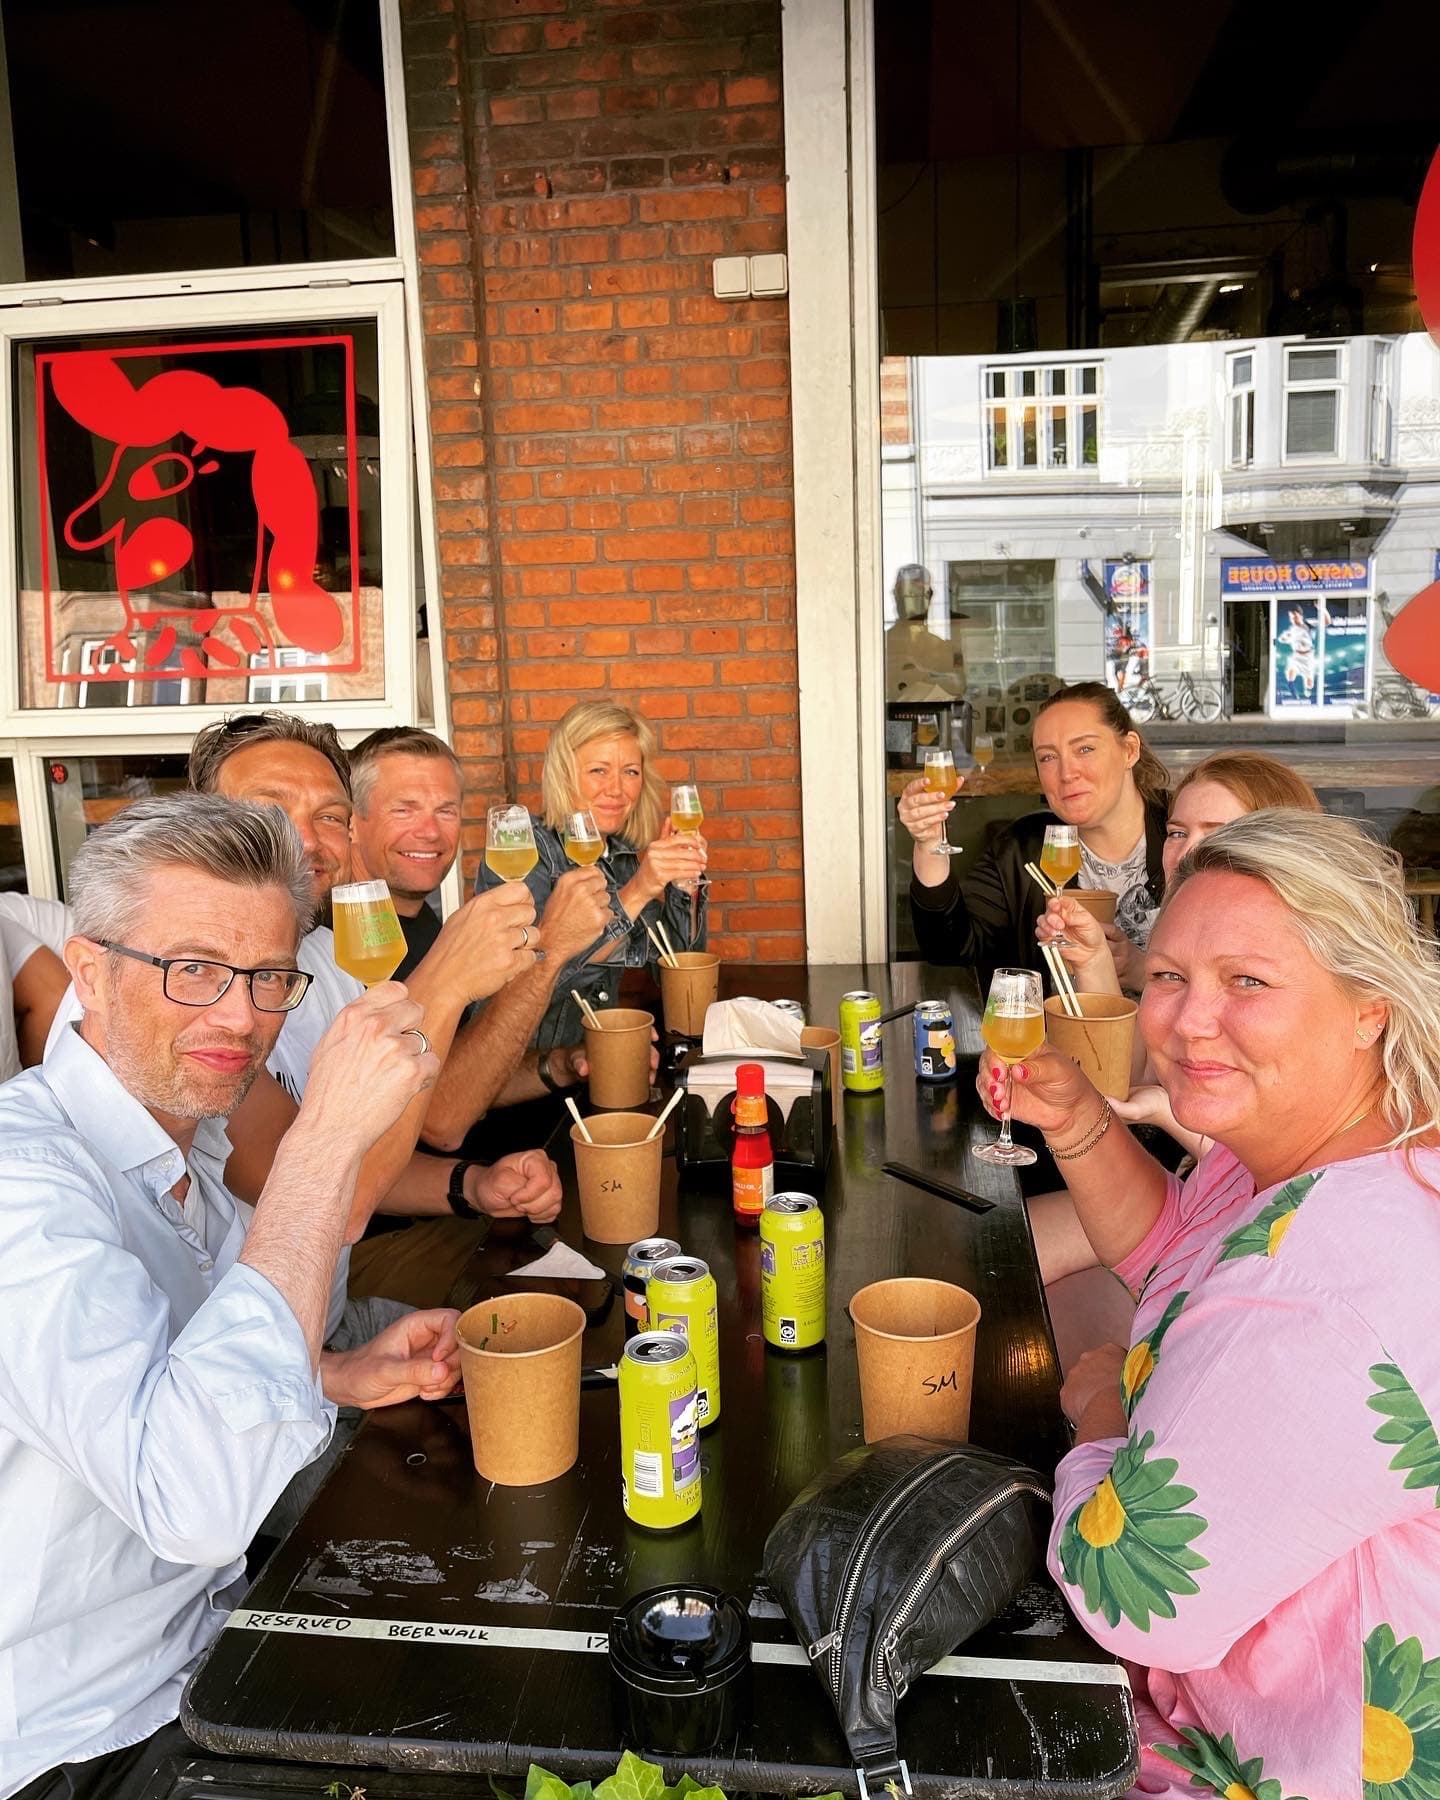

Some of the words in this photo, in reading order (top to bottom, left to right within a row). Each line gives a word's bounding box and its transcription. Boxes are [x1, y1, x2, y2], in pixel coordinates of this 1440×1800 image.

[600, 1180, 622, 1193] SM
[922, 1371, 958, 1395] SM
[246, 1613, 351, 1631] RESERVED
